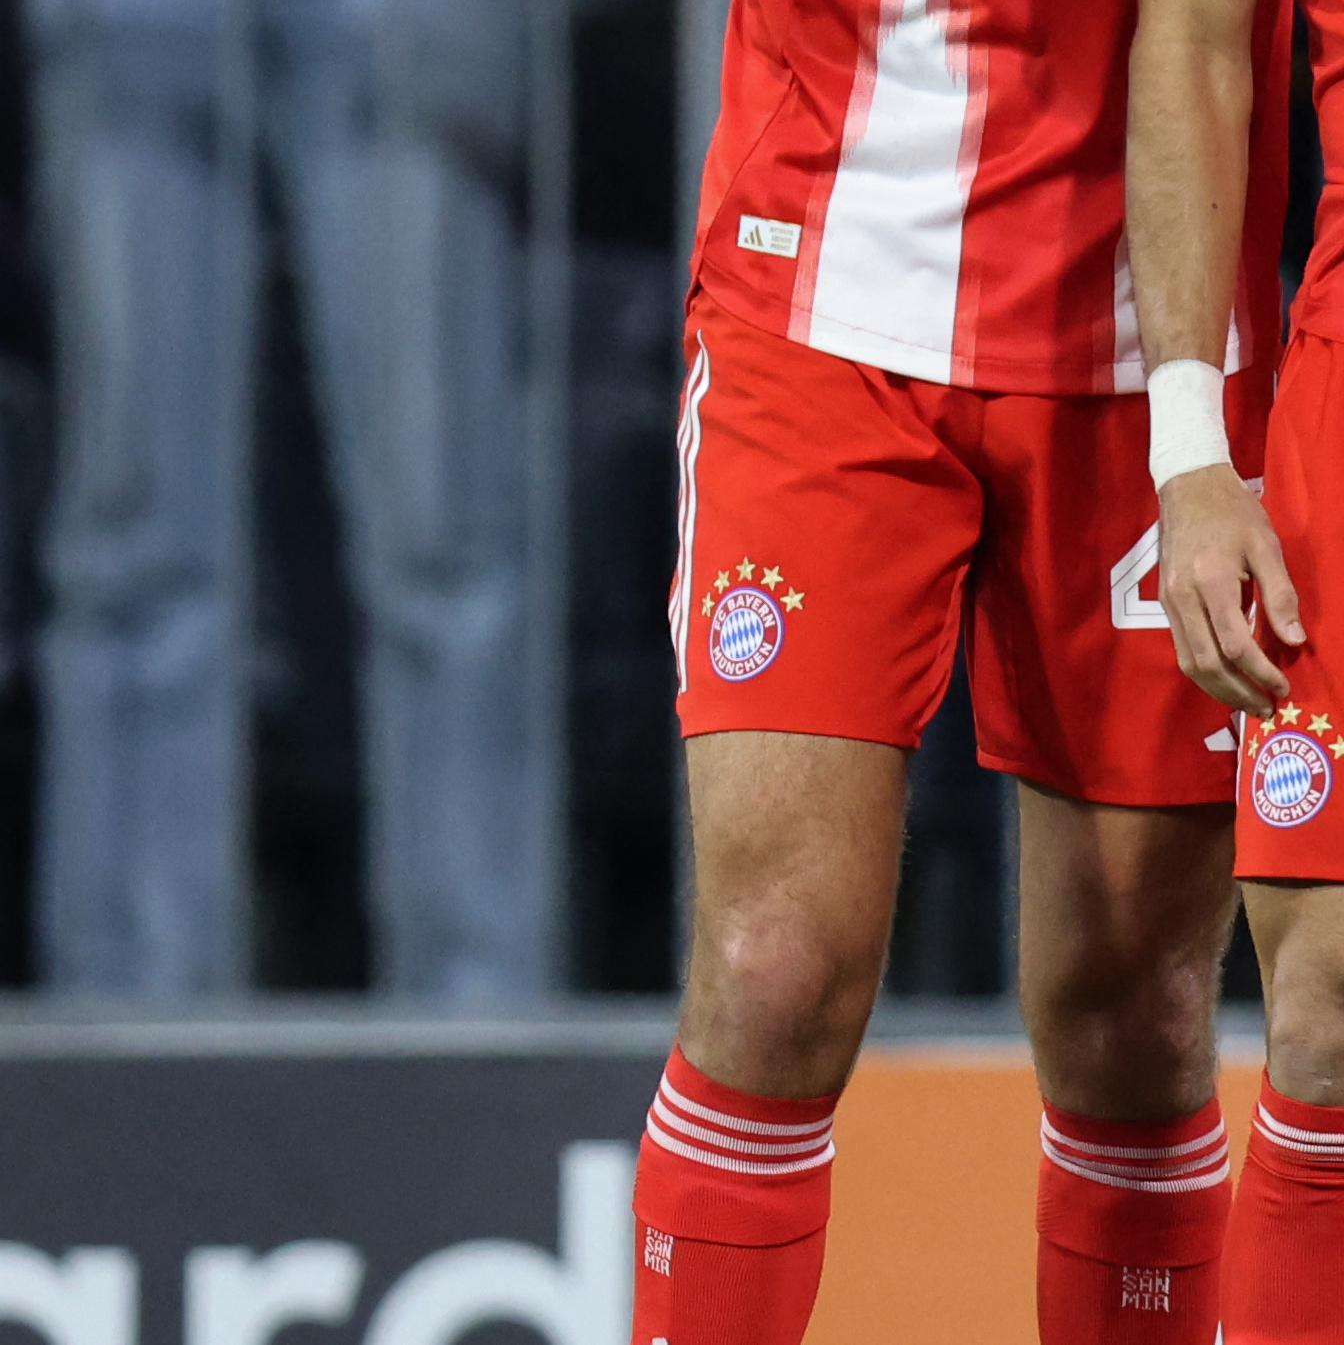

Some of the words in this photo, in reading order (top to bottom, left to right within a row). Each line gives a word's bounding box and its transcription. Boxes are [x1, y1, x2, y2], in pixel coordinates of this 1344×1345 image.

[727, 594, 775, 628] BAYERN
[1257, 752, 1271, 774] FC
[1271, 739, 1324, 775] BAYERN
[644, 1247, 671, 1277] MIA
[645, 1235, 672, 1261] SAN
[1122, 1273, 1170, 1295] SAN
[1121, 1290, 1170, 1313] MIA
